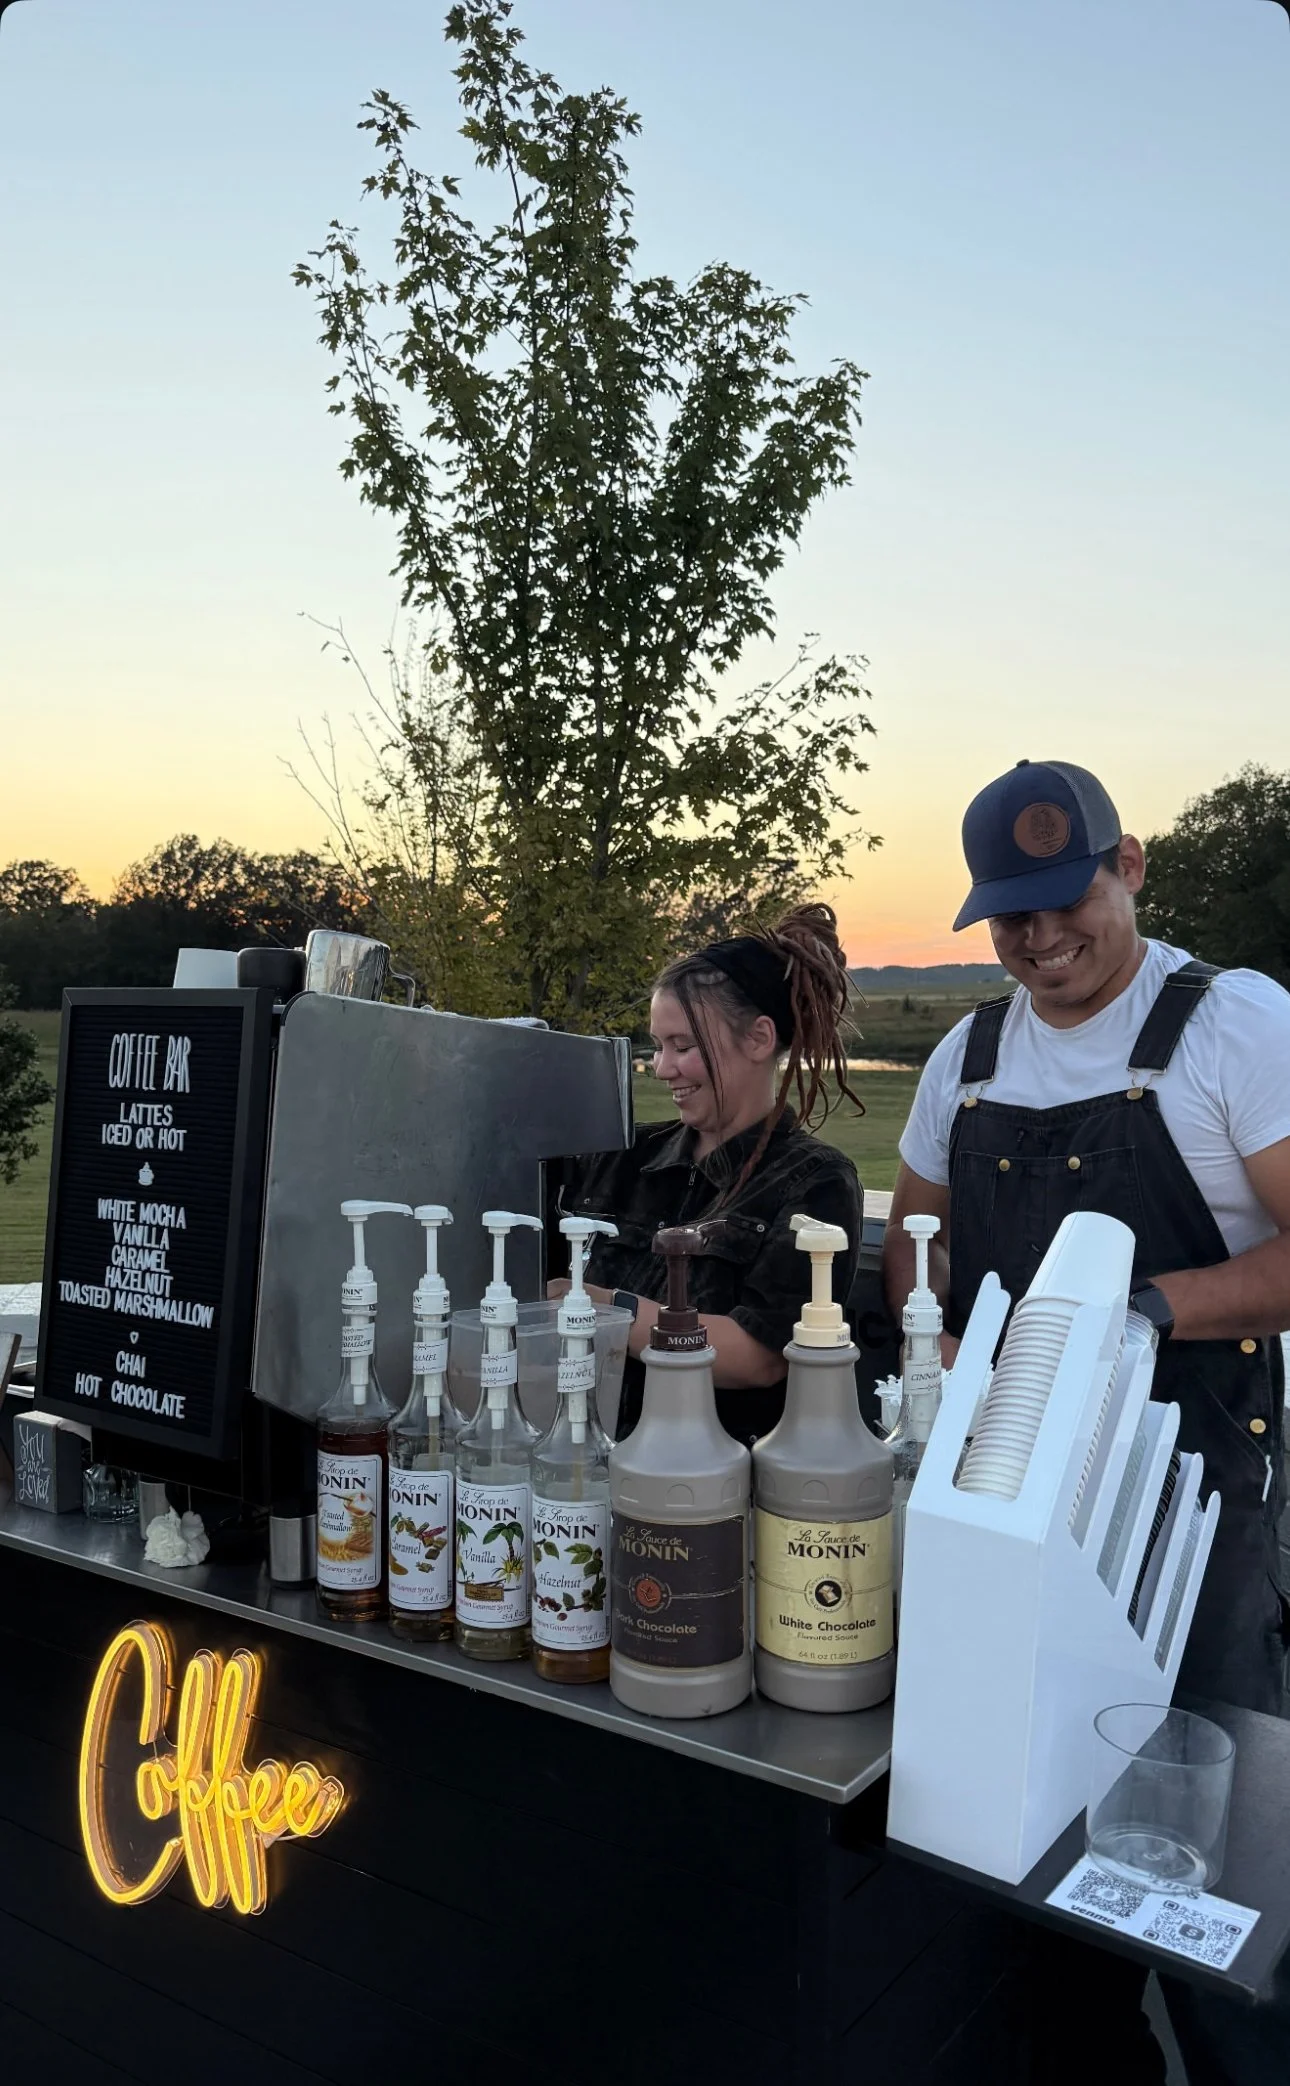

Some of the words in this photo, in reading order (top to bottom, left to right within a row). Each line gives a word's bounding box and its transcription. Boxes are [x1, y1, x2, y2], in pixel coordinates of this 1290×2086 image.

[109, 1033, 160, 1091] COFFEE
[163, 1035, 191, 1093] BAR
[120, 1102, 173, 1127] LATTES
[102, 1124, 132, 1146] ICED
[136, 1127, 154, 1149] OR
[158, 1128, 187, 1151] HOT
[98, 1198, 136, 1222] WHITE
[140, 1203, 186, 1229] MOCHA
[112, 1245, 170, 1273] CARAMEL
[105, 1266, 173, 1297] HAZELNUT
[59, 1280, 111, 1309] TOASTED
[114, 1290, 214, 1328] MARSHMALLOW
[667, 1334, 706, 1346] MONIN
[116, 1350, 146, 1378] CHAI
[75, 1372, 102, 1398] HOT
[111, 1380, 186, 1418] CHOCOLATE
[319, 1473, 367, 1490] ONIN
[418, 1482, 429, 1491] de
[389, 1488, 438, 1506] ONIN
[497, 1498, 509, 1506] de
[547, 1507, 573, 1526] Sirop
[576, 1514, 588, 1522] de
[637, 1528, 668, 1546] Sauce
[669, 1536, 682, 1546] de
[794, 1529, 811, 1543] La
[813, 1530, 847, 1544] Sauce
[849, 1534, 861, 1543] de
[462, 1547, 496, 1564] Vanilla
[619, 1535, 690, 1561] MONIN
[787, 1541, 866, 1559] MONIN
[539, 1571, 581, 1589] Hazelnut
[636, 1618, 697, 1635] Chocolate
[779, 1614, 813, 1631] White
[817, 1619, 877, 1632] Chocolate
[79, 1626, 338, 1914] Coffee
[1070, 1904, 1116, 1925] venmo
